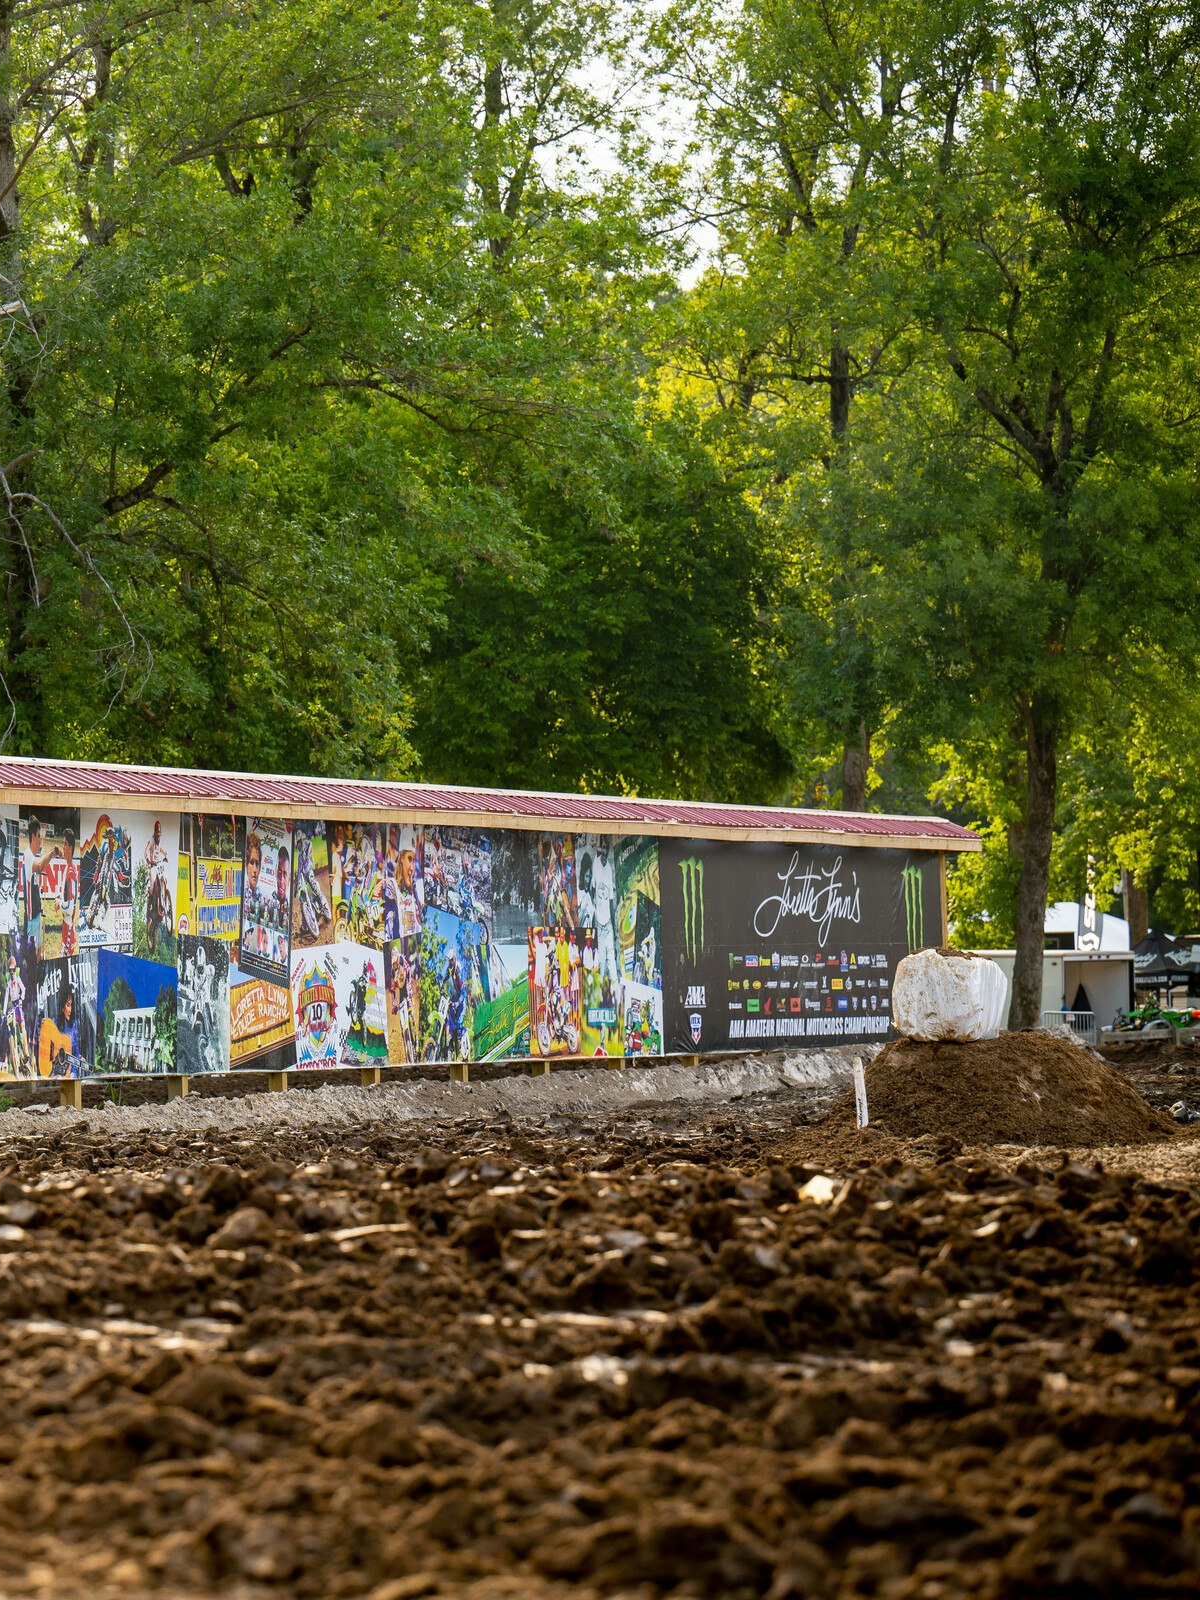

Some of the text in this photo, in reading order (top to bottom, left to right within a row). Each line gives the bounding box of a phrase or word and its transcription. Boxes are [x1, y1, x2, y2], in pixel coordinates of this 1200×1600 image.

[684, 985, 707, 1005] AMA
[230, 986, 265, 1027] LORETTA
[311, 1003, 323, 1021] 10
[729, 1020, 744, 1038] AMA
[776, 1018, 805, 1036] NATIONAL
[806, 1017, 843, 1035] MOTOCROSS
[844, 1015, 890, 1034] CHAMPIONSHIP
